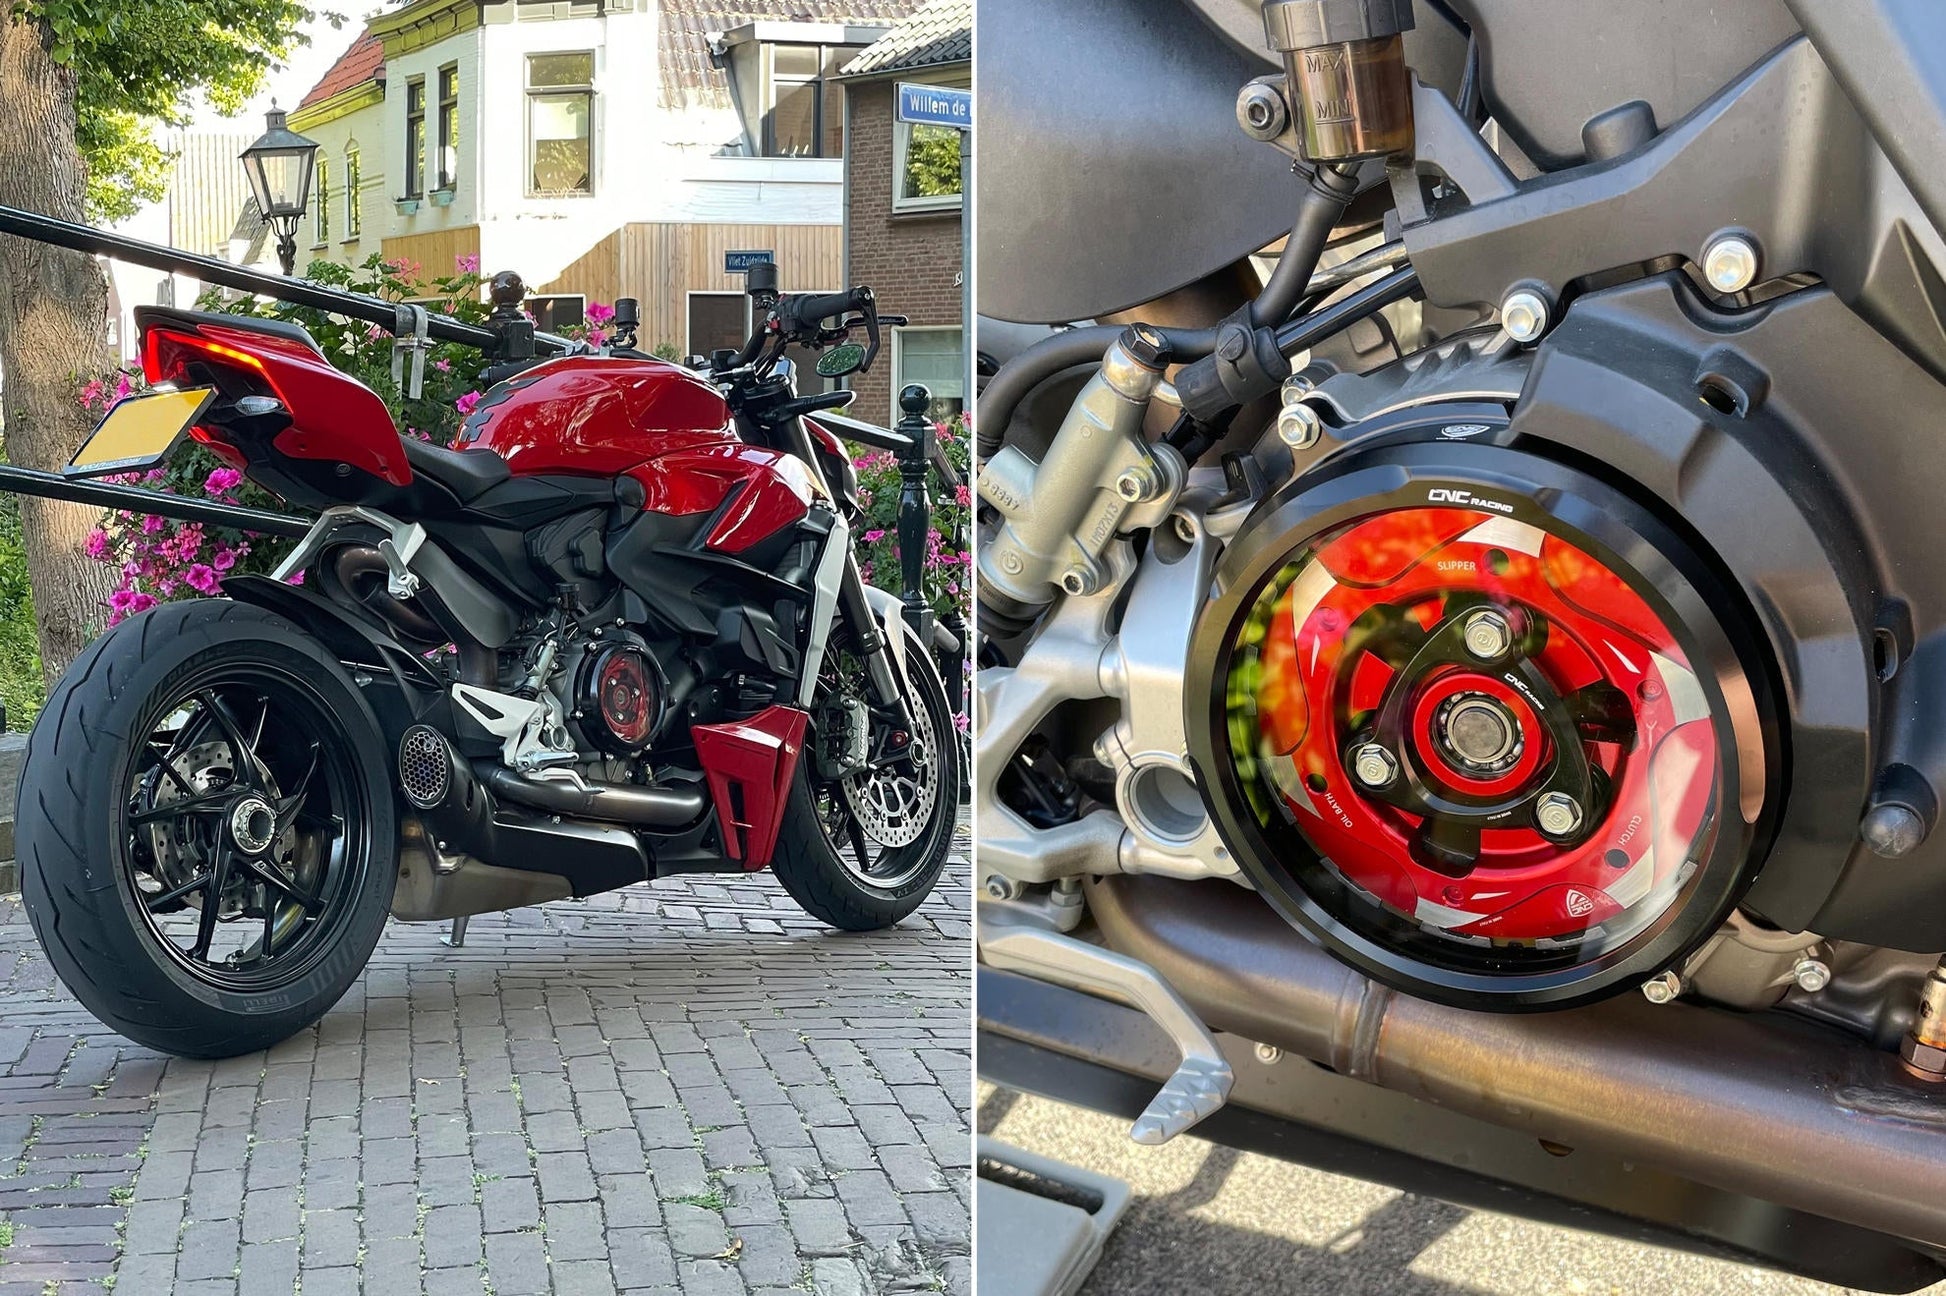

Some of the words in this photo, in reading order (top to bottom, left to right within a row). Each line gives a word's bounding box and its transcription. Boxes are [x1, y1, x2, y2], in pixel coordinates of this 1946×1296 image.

[1306, 52, 1347, 73] MAX
[910, 94, 949, 115] Willem
[952, 99, 966, 116] de
[1316, 98, 1351, 118] MIN
[1428, 488, 1472, 504] CNC
[1470, 497, 1514, 513] RACING
[1437, 560, 1476, 571] SLIPPER
[1504, 672, 1529, 691] CNC
[1324, 792, 1344, 815] BATH
[1340, 813, 1353, 828] OIL
[1618, 815, 1642, 846] CLUTCH
